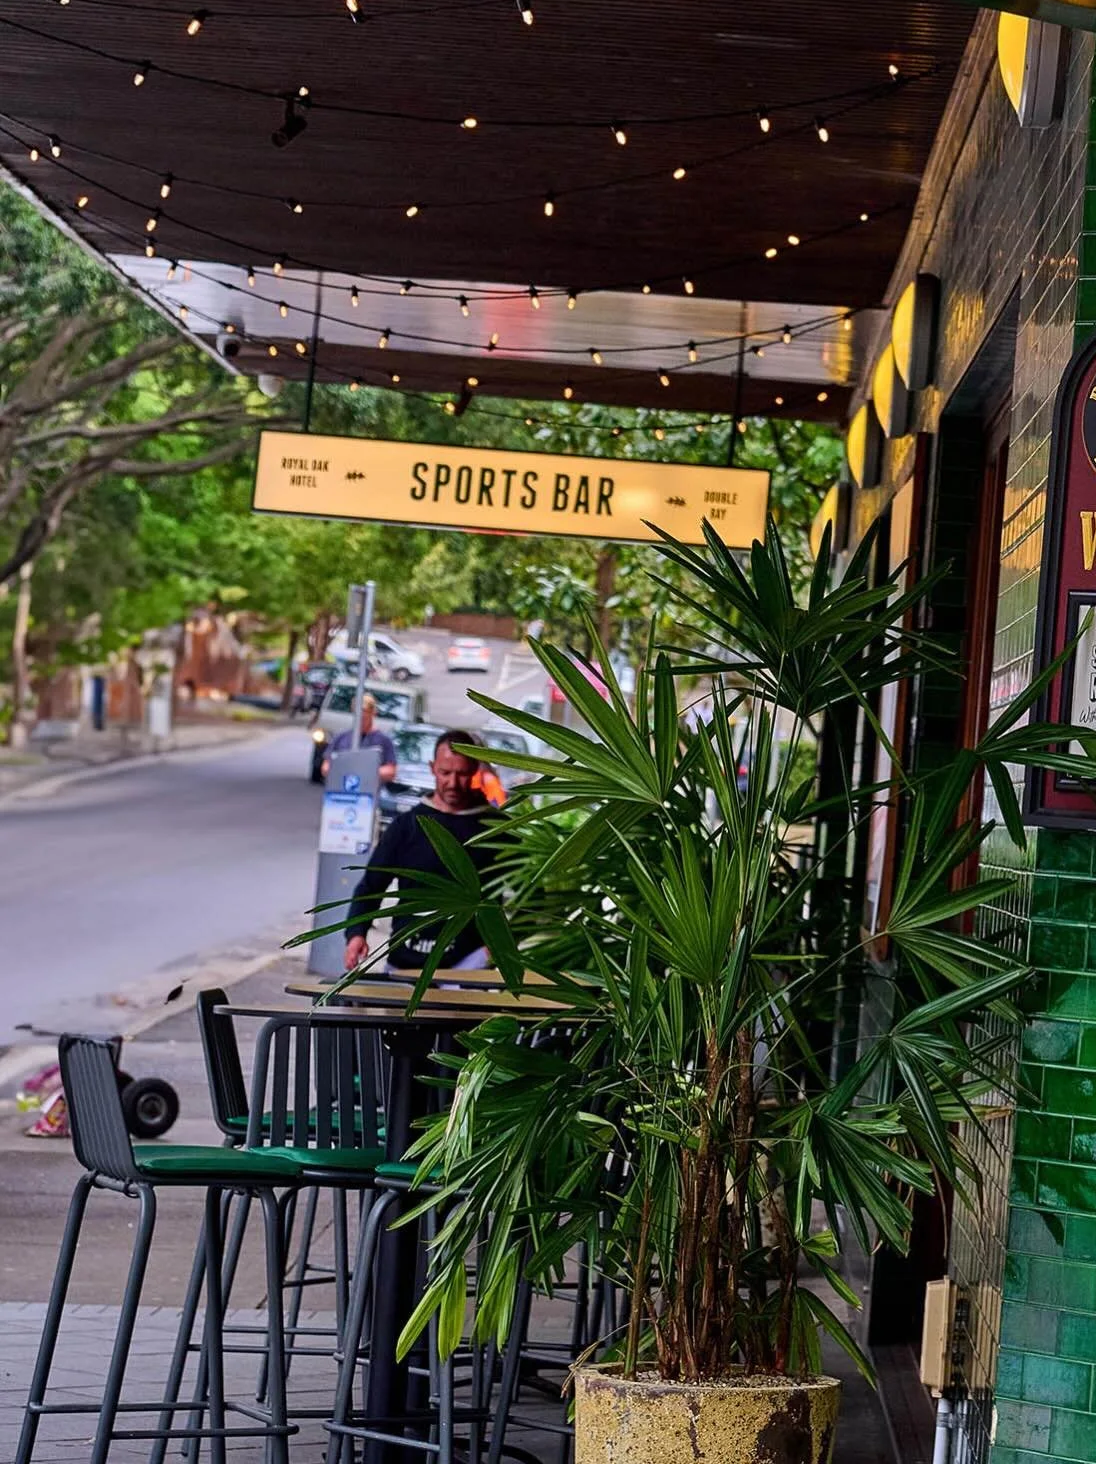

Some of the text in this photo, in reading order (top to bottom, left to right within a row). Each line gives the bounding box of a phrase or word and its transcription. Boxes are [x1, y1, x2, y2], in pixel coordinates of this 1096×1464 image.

[410, 461, 615, 517] SPORTS BAR
[1079, 706, 1096, 723] With
